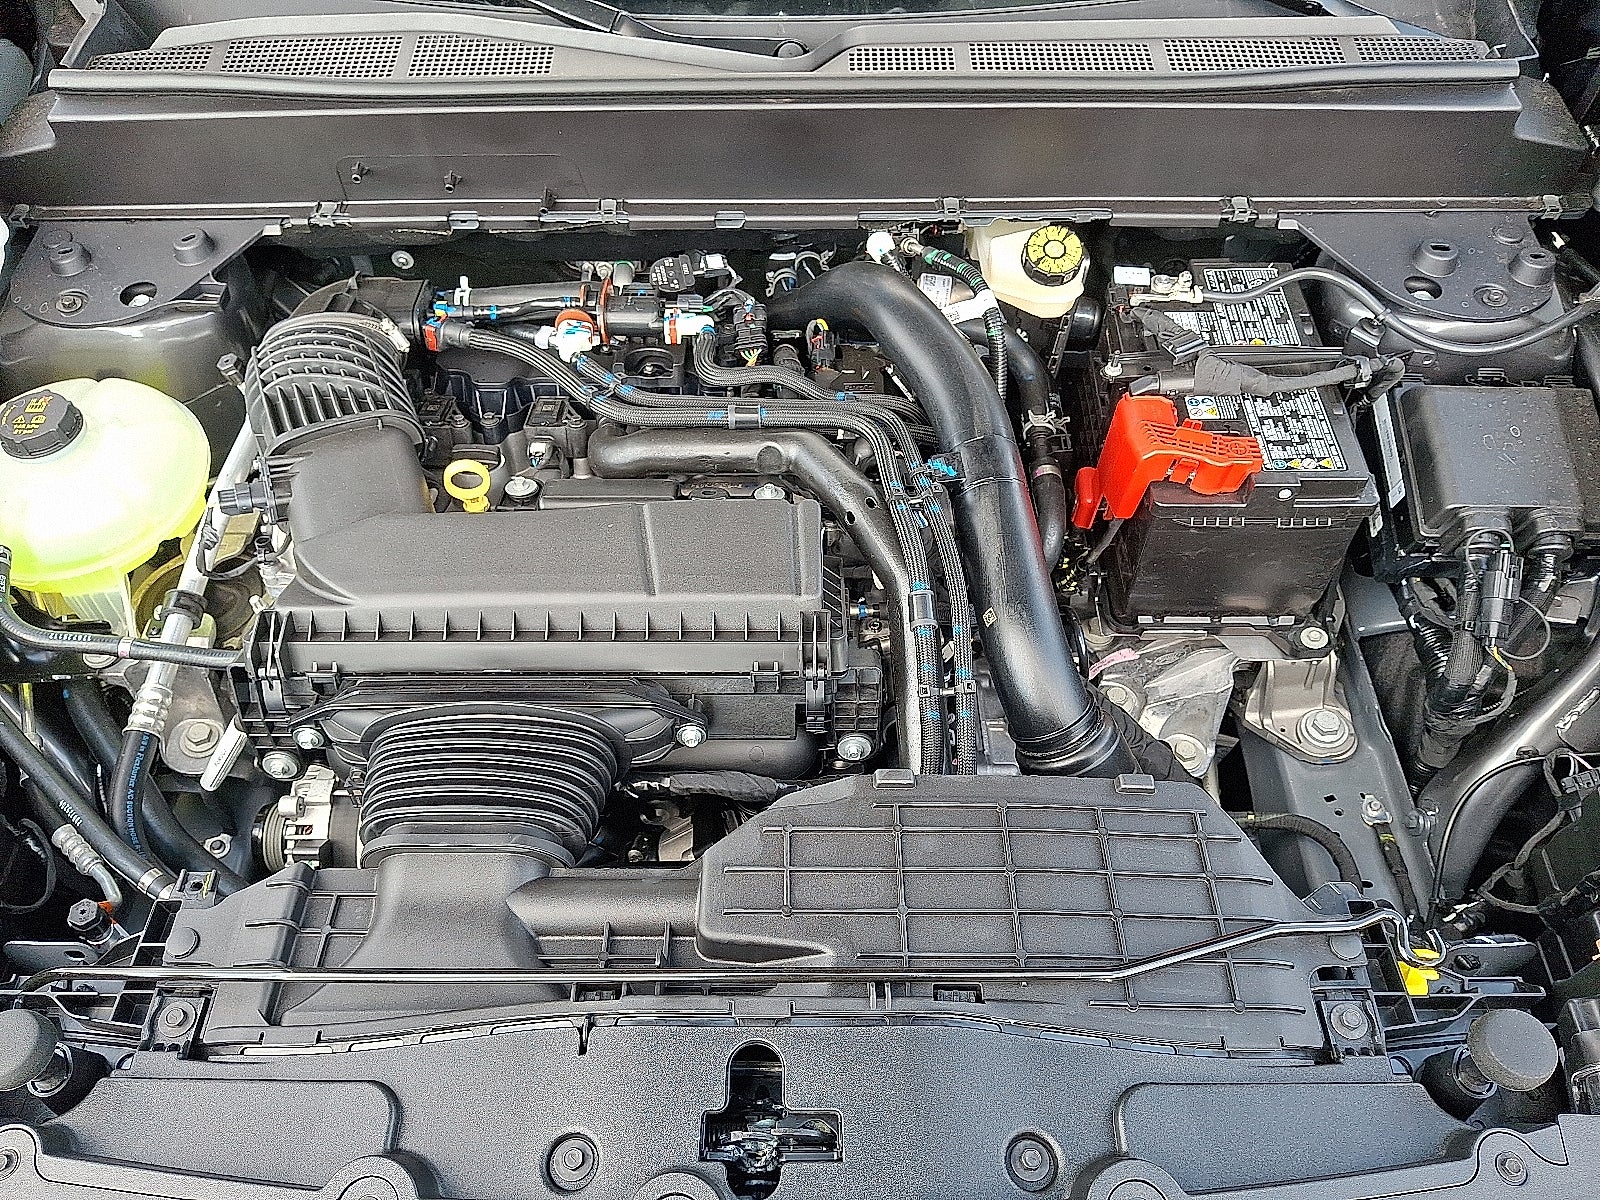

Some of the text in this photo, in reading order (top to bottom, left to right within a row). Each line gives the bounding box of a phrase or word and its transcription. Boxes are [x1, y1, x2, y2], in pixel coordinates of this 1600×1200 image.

[128, 752, 145, 789] Flexbarrier
[125, 800, 135, 828] SUCTION
[128, 827, 139, 845] HOSE
